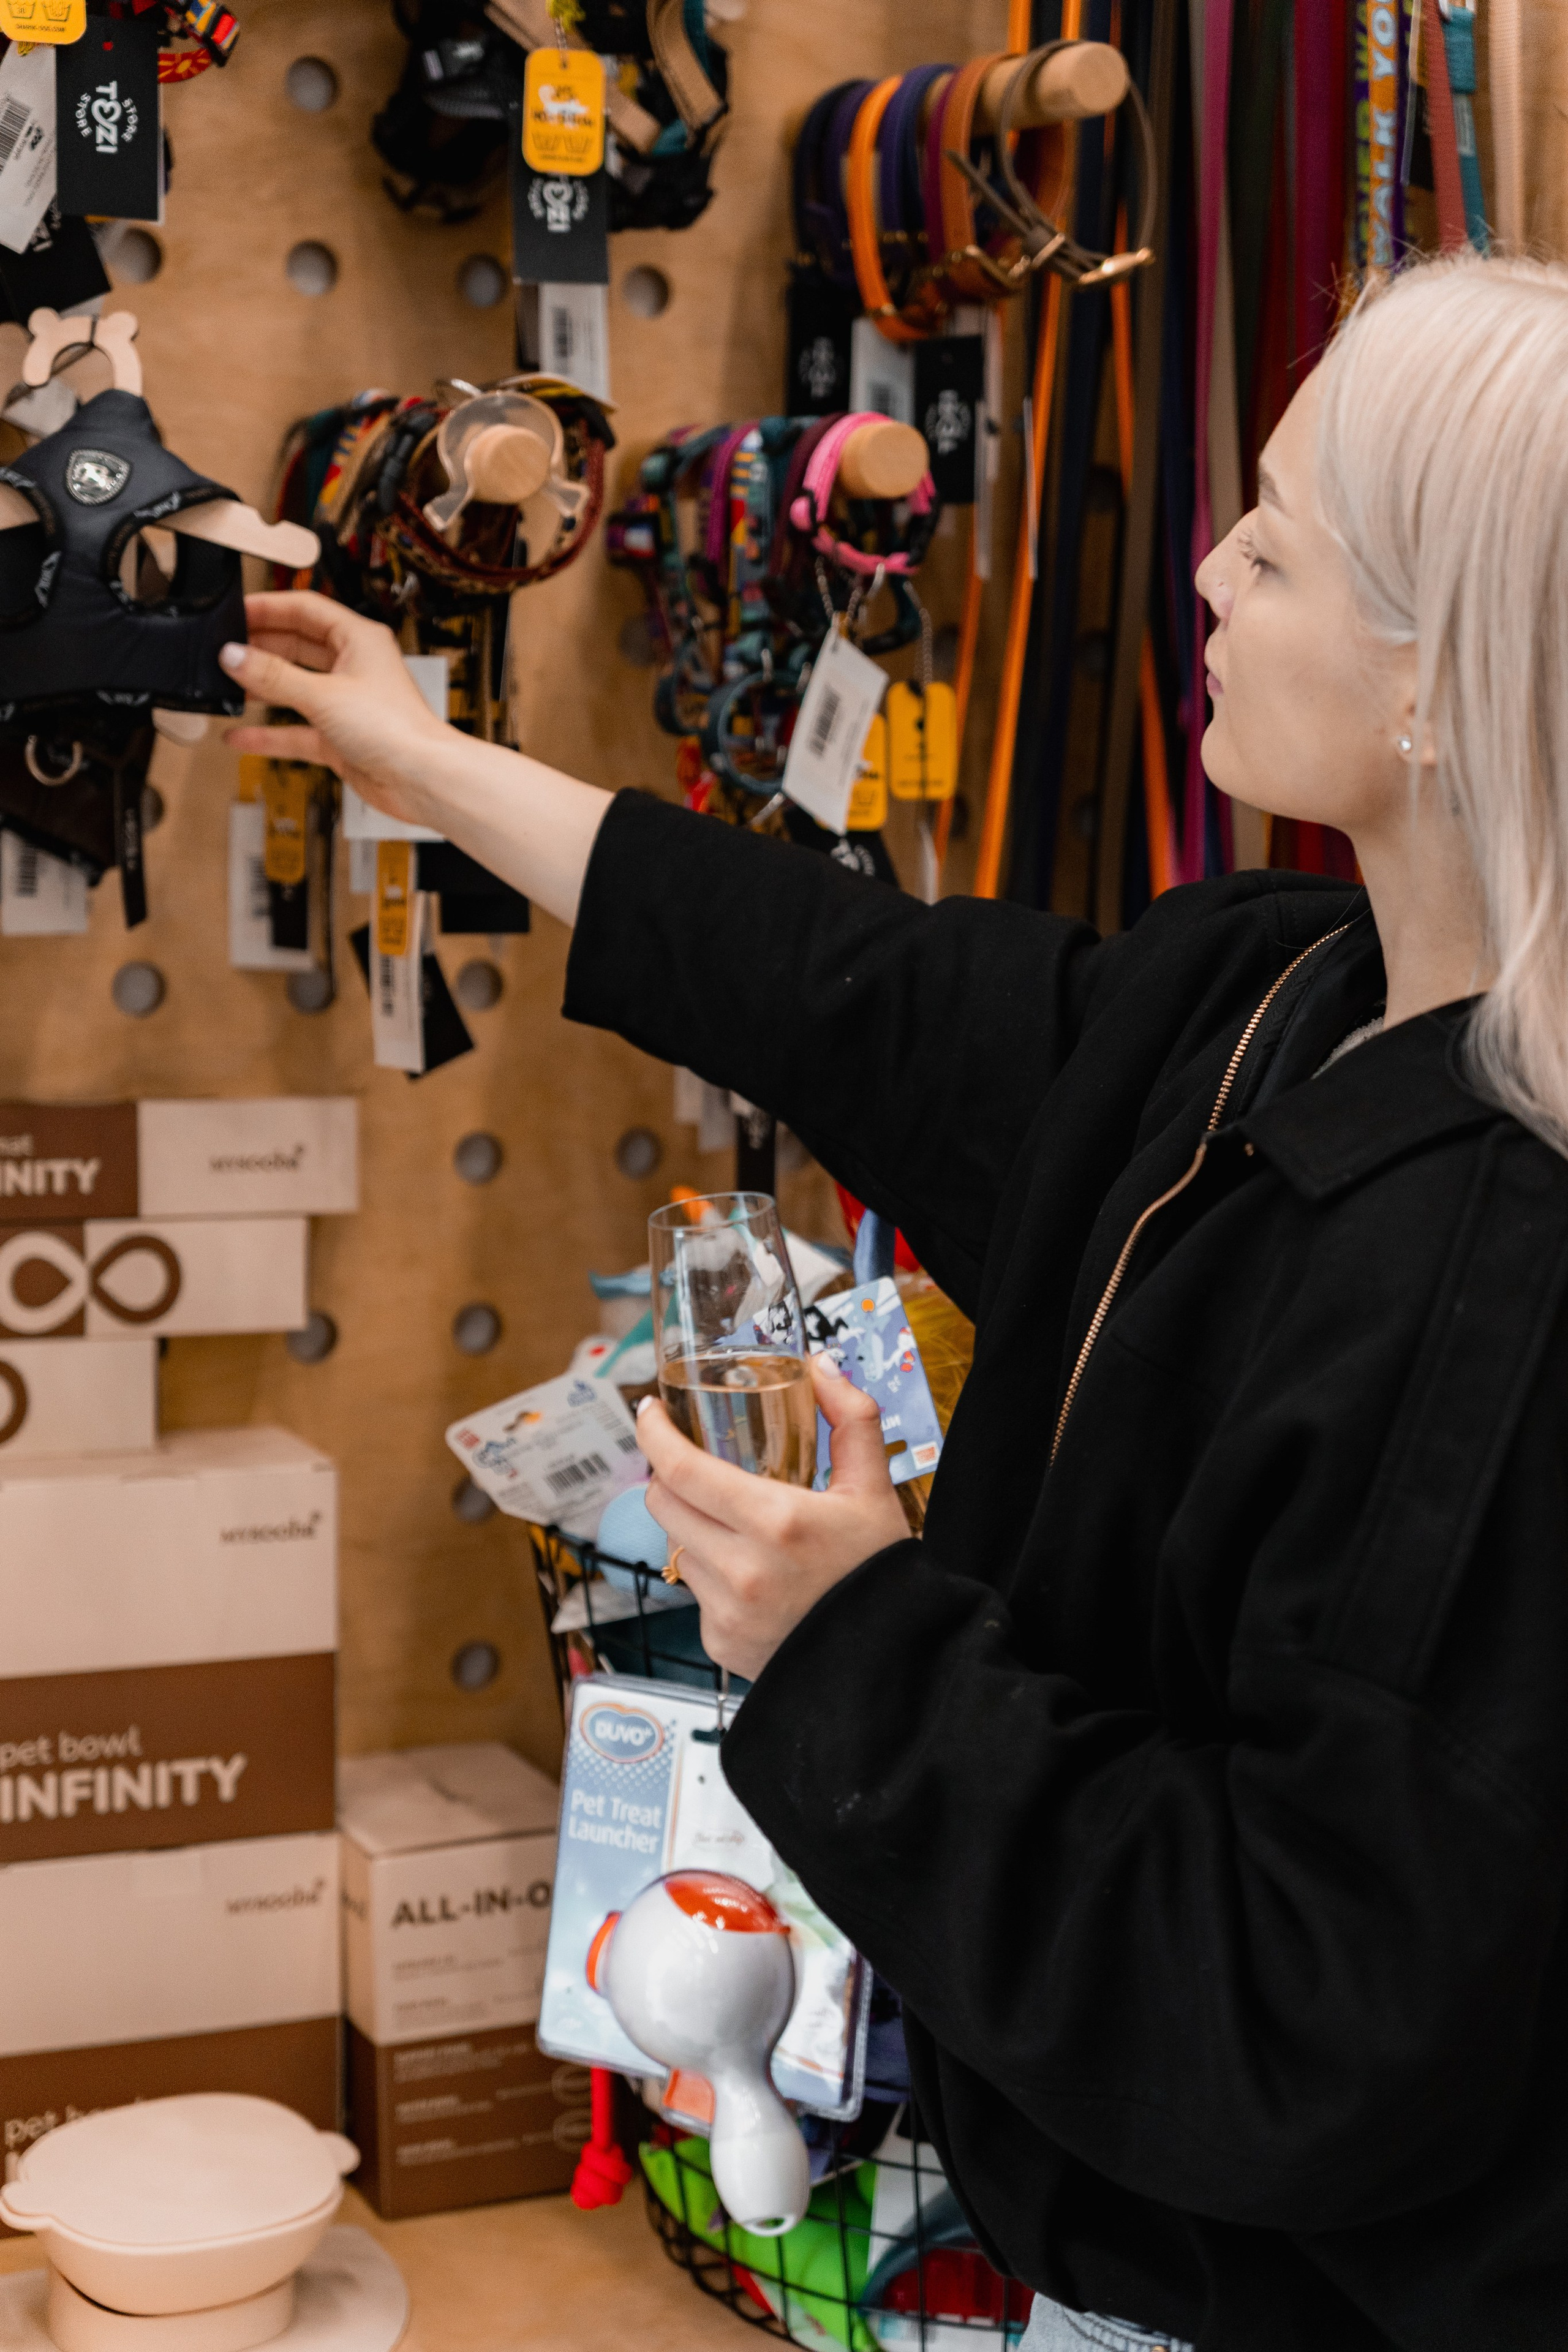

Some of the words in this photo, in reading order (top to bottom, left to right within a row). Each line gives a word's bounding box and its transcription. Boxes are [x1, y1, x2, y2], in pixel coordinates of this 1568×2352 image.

[75, 92, 93, 138] STORE
[121, 97, 138, 143] STORE
[0, 1156, 100, 1196] NITY
[59, 1724, 142, 1763] bowl
[0, 1754, 246, 1823] INFINITY
[571, 1787, 606, 1819] Pet
[611, 1795, 663, 1830] Treat
[568, 1814, 659, 1855] Launcher
